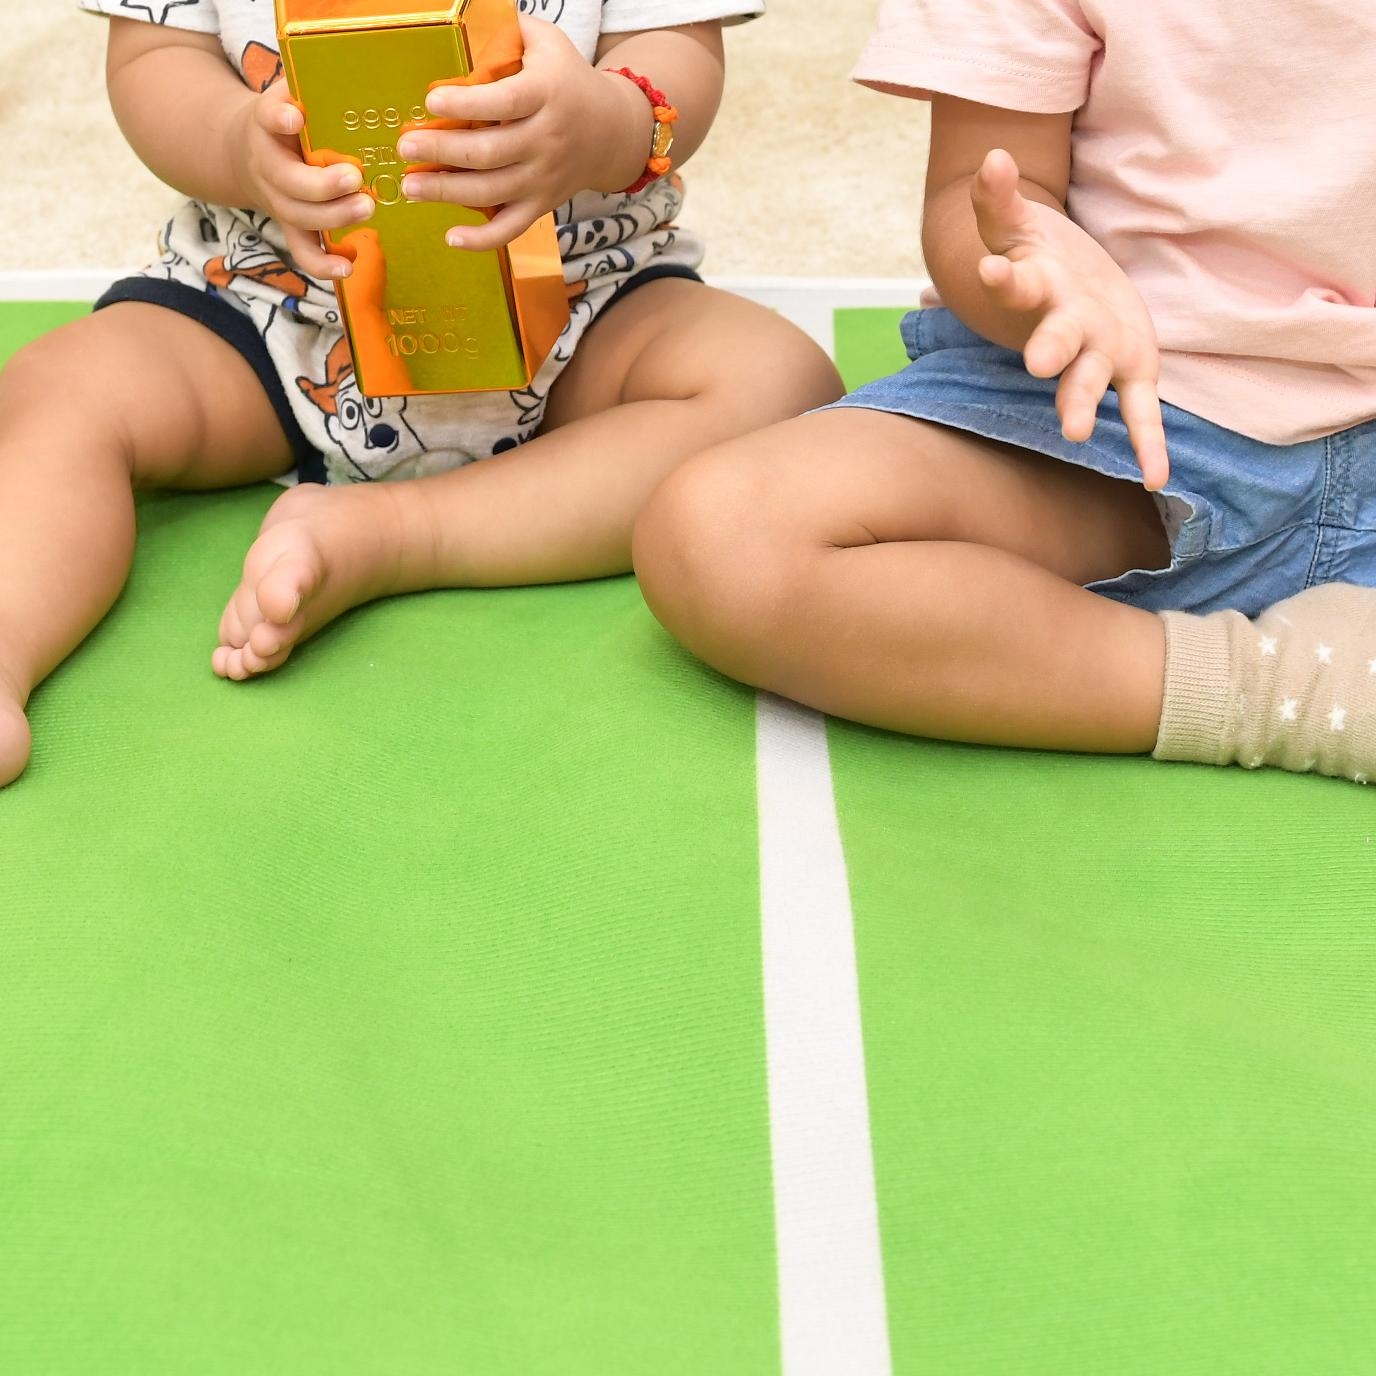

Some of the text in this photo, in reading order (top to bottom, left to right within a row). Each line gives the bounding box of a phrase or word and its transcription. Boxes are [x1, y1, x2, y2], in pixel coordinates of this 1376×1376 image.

[343, 105, 427, 131] 999.9
[387, 308, 427, 326] NET
[384, 331, 481, 360] 1000g
